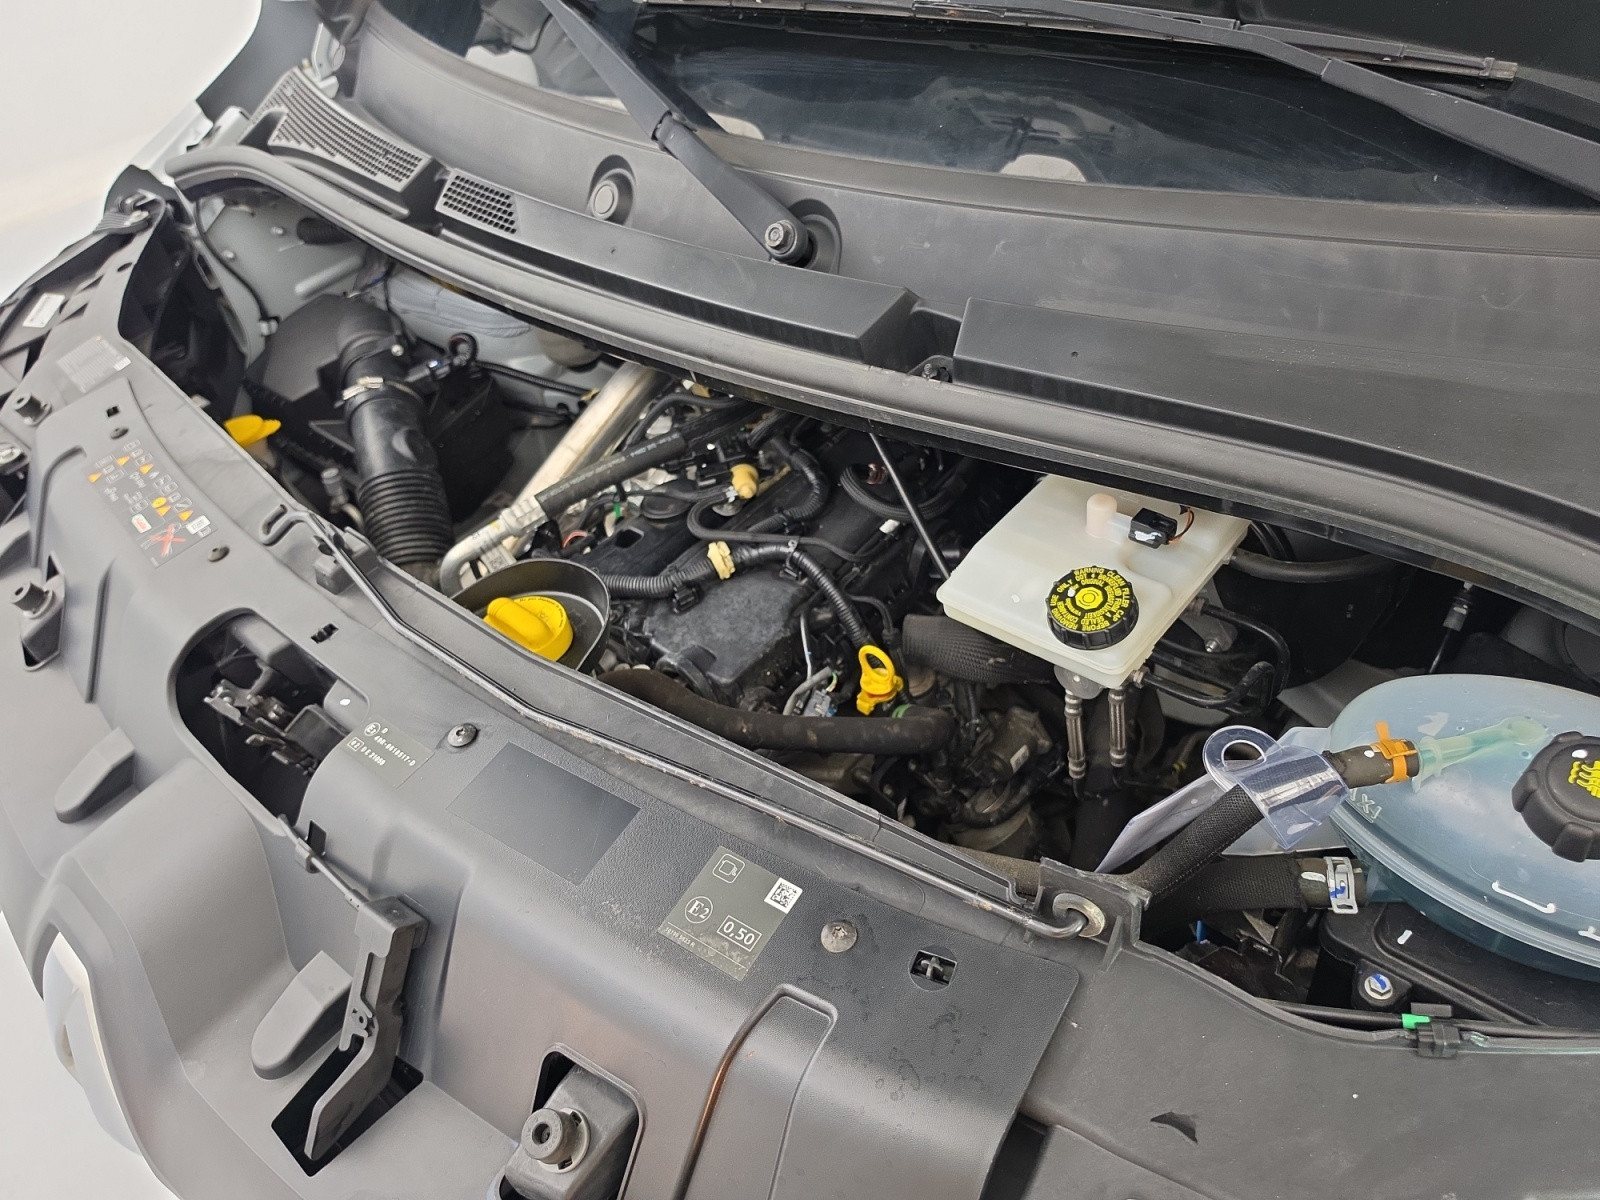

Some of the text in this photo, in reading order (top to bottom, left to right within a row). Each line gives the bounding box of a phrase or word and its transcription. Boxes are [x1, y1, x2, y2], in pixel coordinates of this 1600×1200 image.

[1050, 567, 1130, 631] WARNING CLEAN FILLER CAP BEFORE REMOVING USE ONLY
[1111, 598, 1122, 612] FROM
[1057, 601, 1078, 624] CONTAINER
[1081, 616, 1104, 625] SEALED
[688, 900, 709, 919] E2
[723, 921, 754, 945] 0,50
